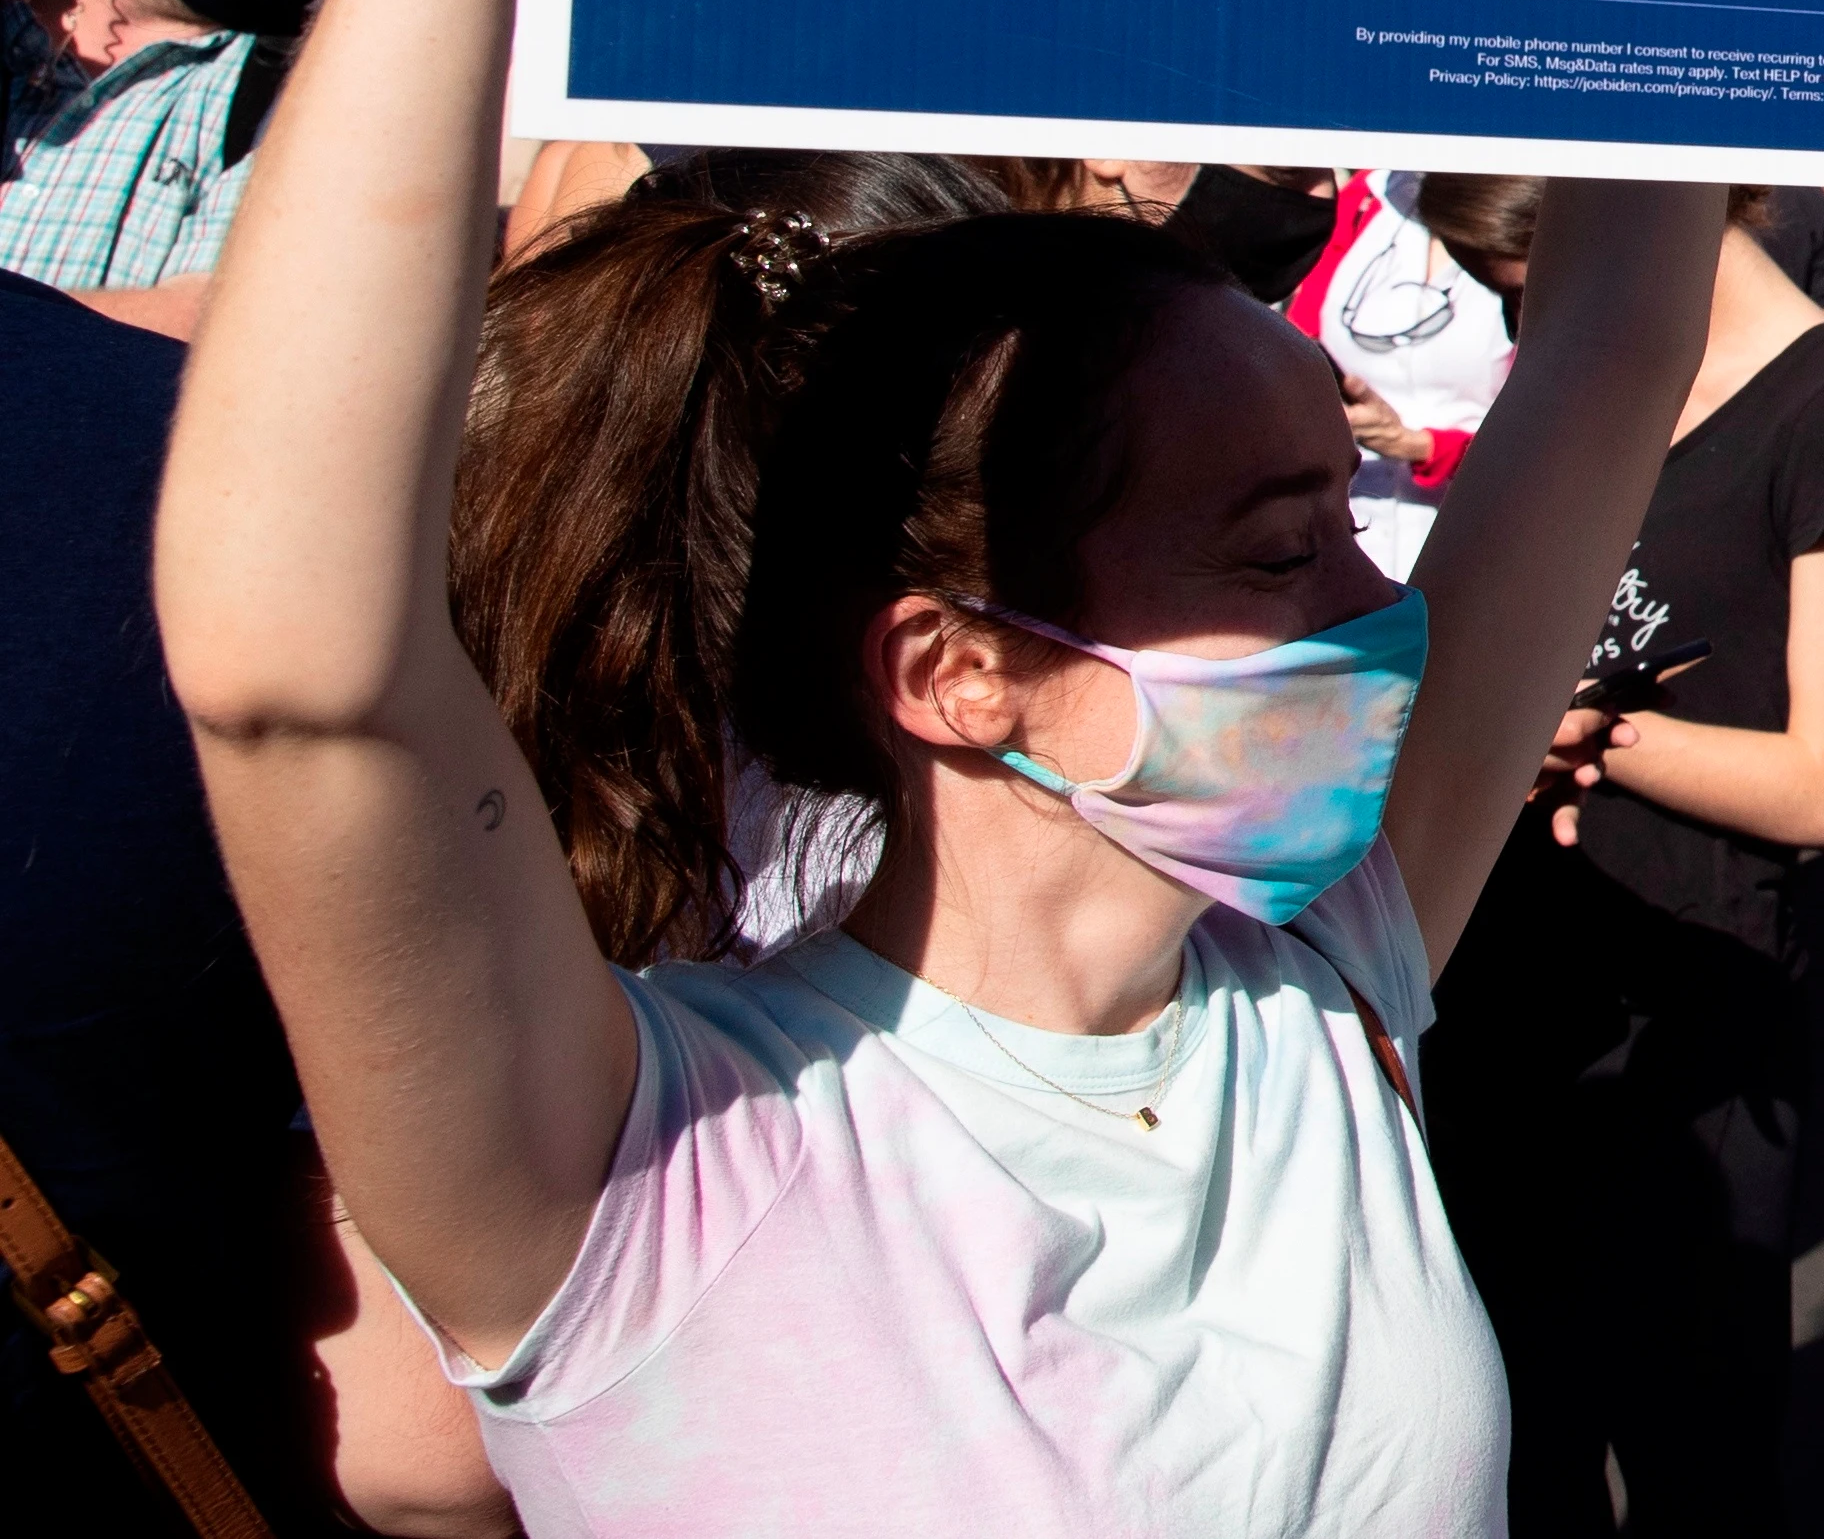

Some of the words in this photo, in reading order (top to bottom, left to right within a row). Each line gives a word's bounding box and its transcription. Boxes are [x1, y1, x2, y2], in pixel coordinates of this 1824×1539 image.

[1356, 28, 1375, 44] By
[1379, 31, 1445, 47] providing
[1449, 36, 1470, 49] my
[1475, 36, 1521, 49] mobile
[1525, 38, 1568, 52] phone
[1572, 42, 1623, 54] number
[1627, 43, 1631, 55] I
[1634, 46, 1687, 58] consent
[1691, 48, 1705, 59] to
[1708, 50, 1754, 62] receive
[1758, 53, 1815, 68] recurring
[1478, 53, 1500, 66] For
[1504, 54, 1541, 69] SMS,
[1546, 57, 1616, 73] Msg&Data
[1620, 62, 1653, 74] rates
[1657, 66, 1685, 79] may
[1688, 66, 1727, 81] apply.
[1732, 67, 1760, 80] Text
[1764, 69, 1800, 82] HELP
[1804, 71, 1821, 83] for
[1430, 69, 1481, 87] Privacy
[1485, 72, 1530, 89] Policy:
[1781, 87, 1823, 101] Terms:
